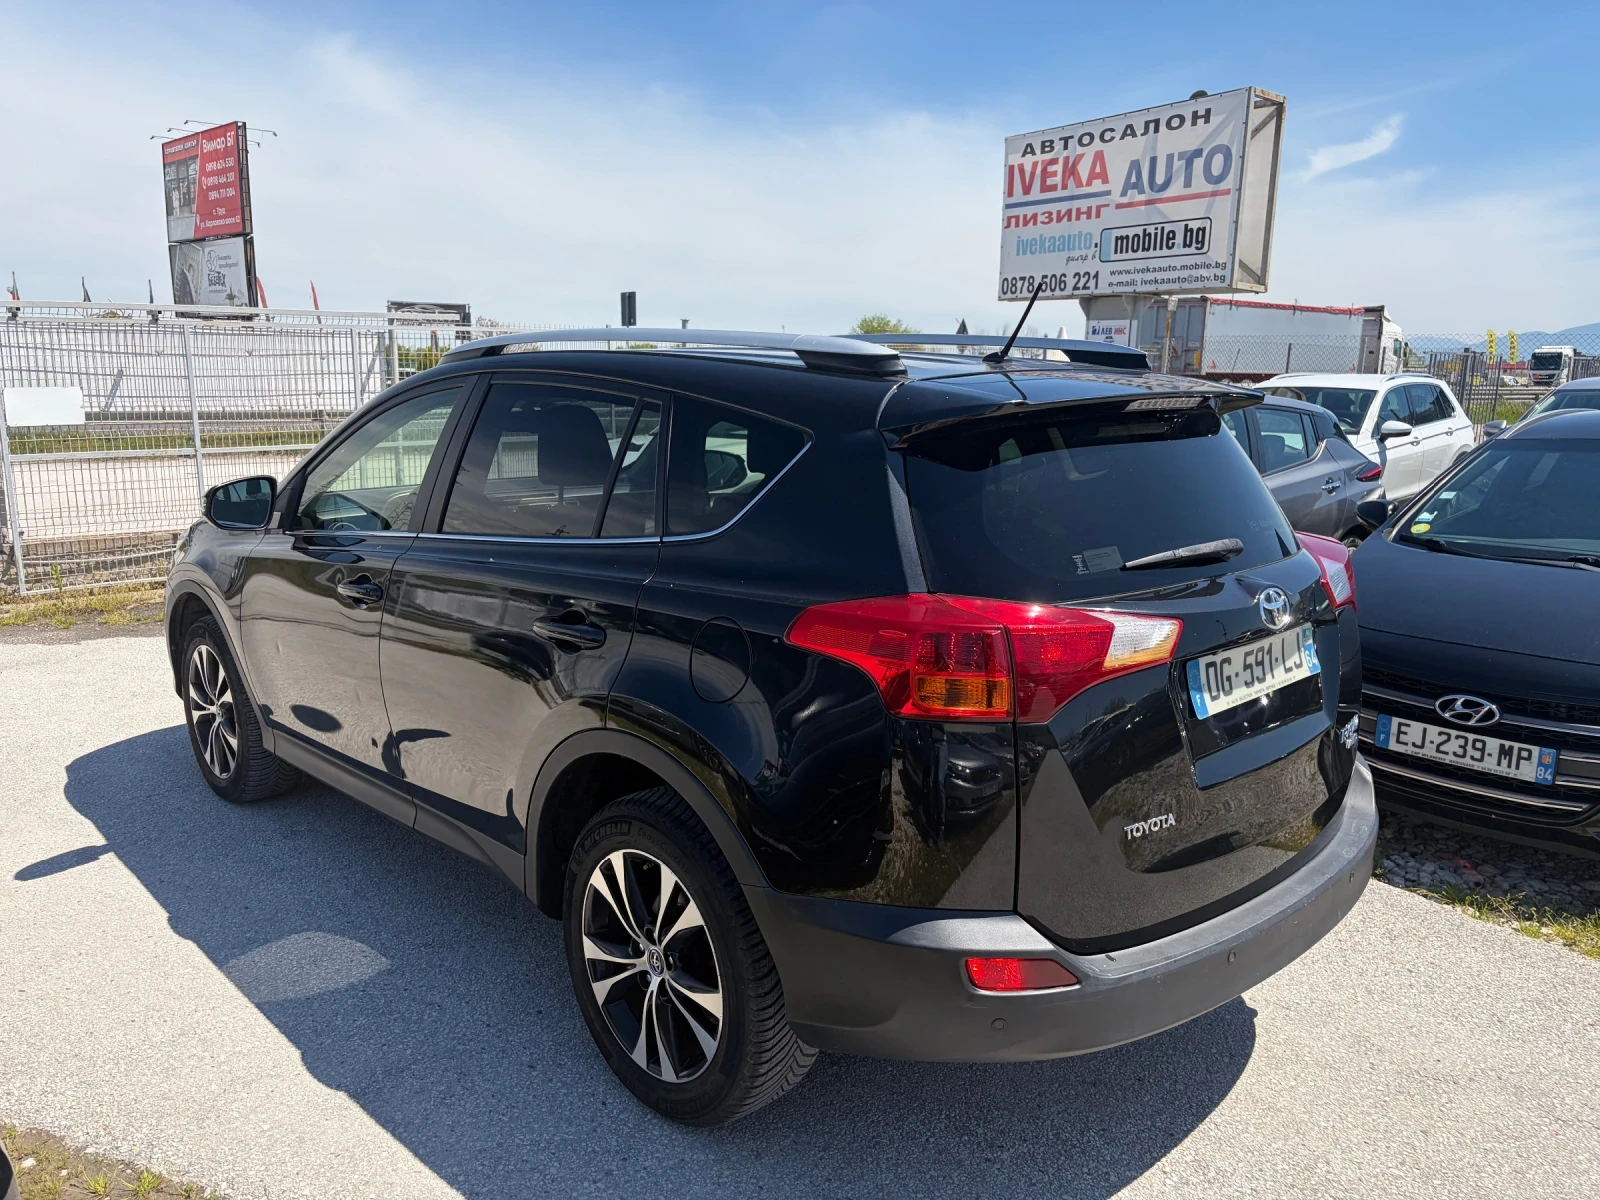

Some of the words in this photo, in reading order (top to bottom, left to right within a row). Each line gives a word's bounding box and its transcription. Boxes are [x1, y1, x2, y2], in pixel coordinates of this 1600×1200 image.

[202, 136, 226, 153] Вимар
[226, 131, 235, 147] БГ
[1020, 107, 1212, 158] АВТОСАЛОН
[1006, 149, 1110, 198] IVEKA
[1119, 143, 1233, 198] AUTO
[1003, 203, 1110, 230] ЛИЗИНГ
[1114, 224, 1207, 255] mobile.bg
[1066, 253, 1089, 266] дилър
[1109, 261, 1227, 277] www.ivekaauto.mobile.bg
[1001, 275, 1036, 295] 0878
[1040, 273, 1067, 293] 506
[1072, 270, 1100, 292] 221
[1108, 278, 1138, 288] e-mail:
[1140, 273, 1226, 287] ivekaauto@abv.bg
[1304, 650, 1318, 667] 64
[1380, 734, 1385, 742] F
[1395, 722, 1533, 770] EJ-239-MP
[1537, 767, 1552, 780] 84
[583, 822, 630, 849] MICHELIN
[1123, 813, 1176, 840] TOYOTA
